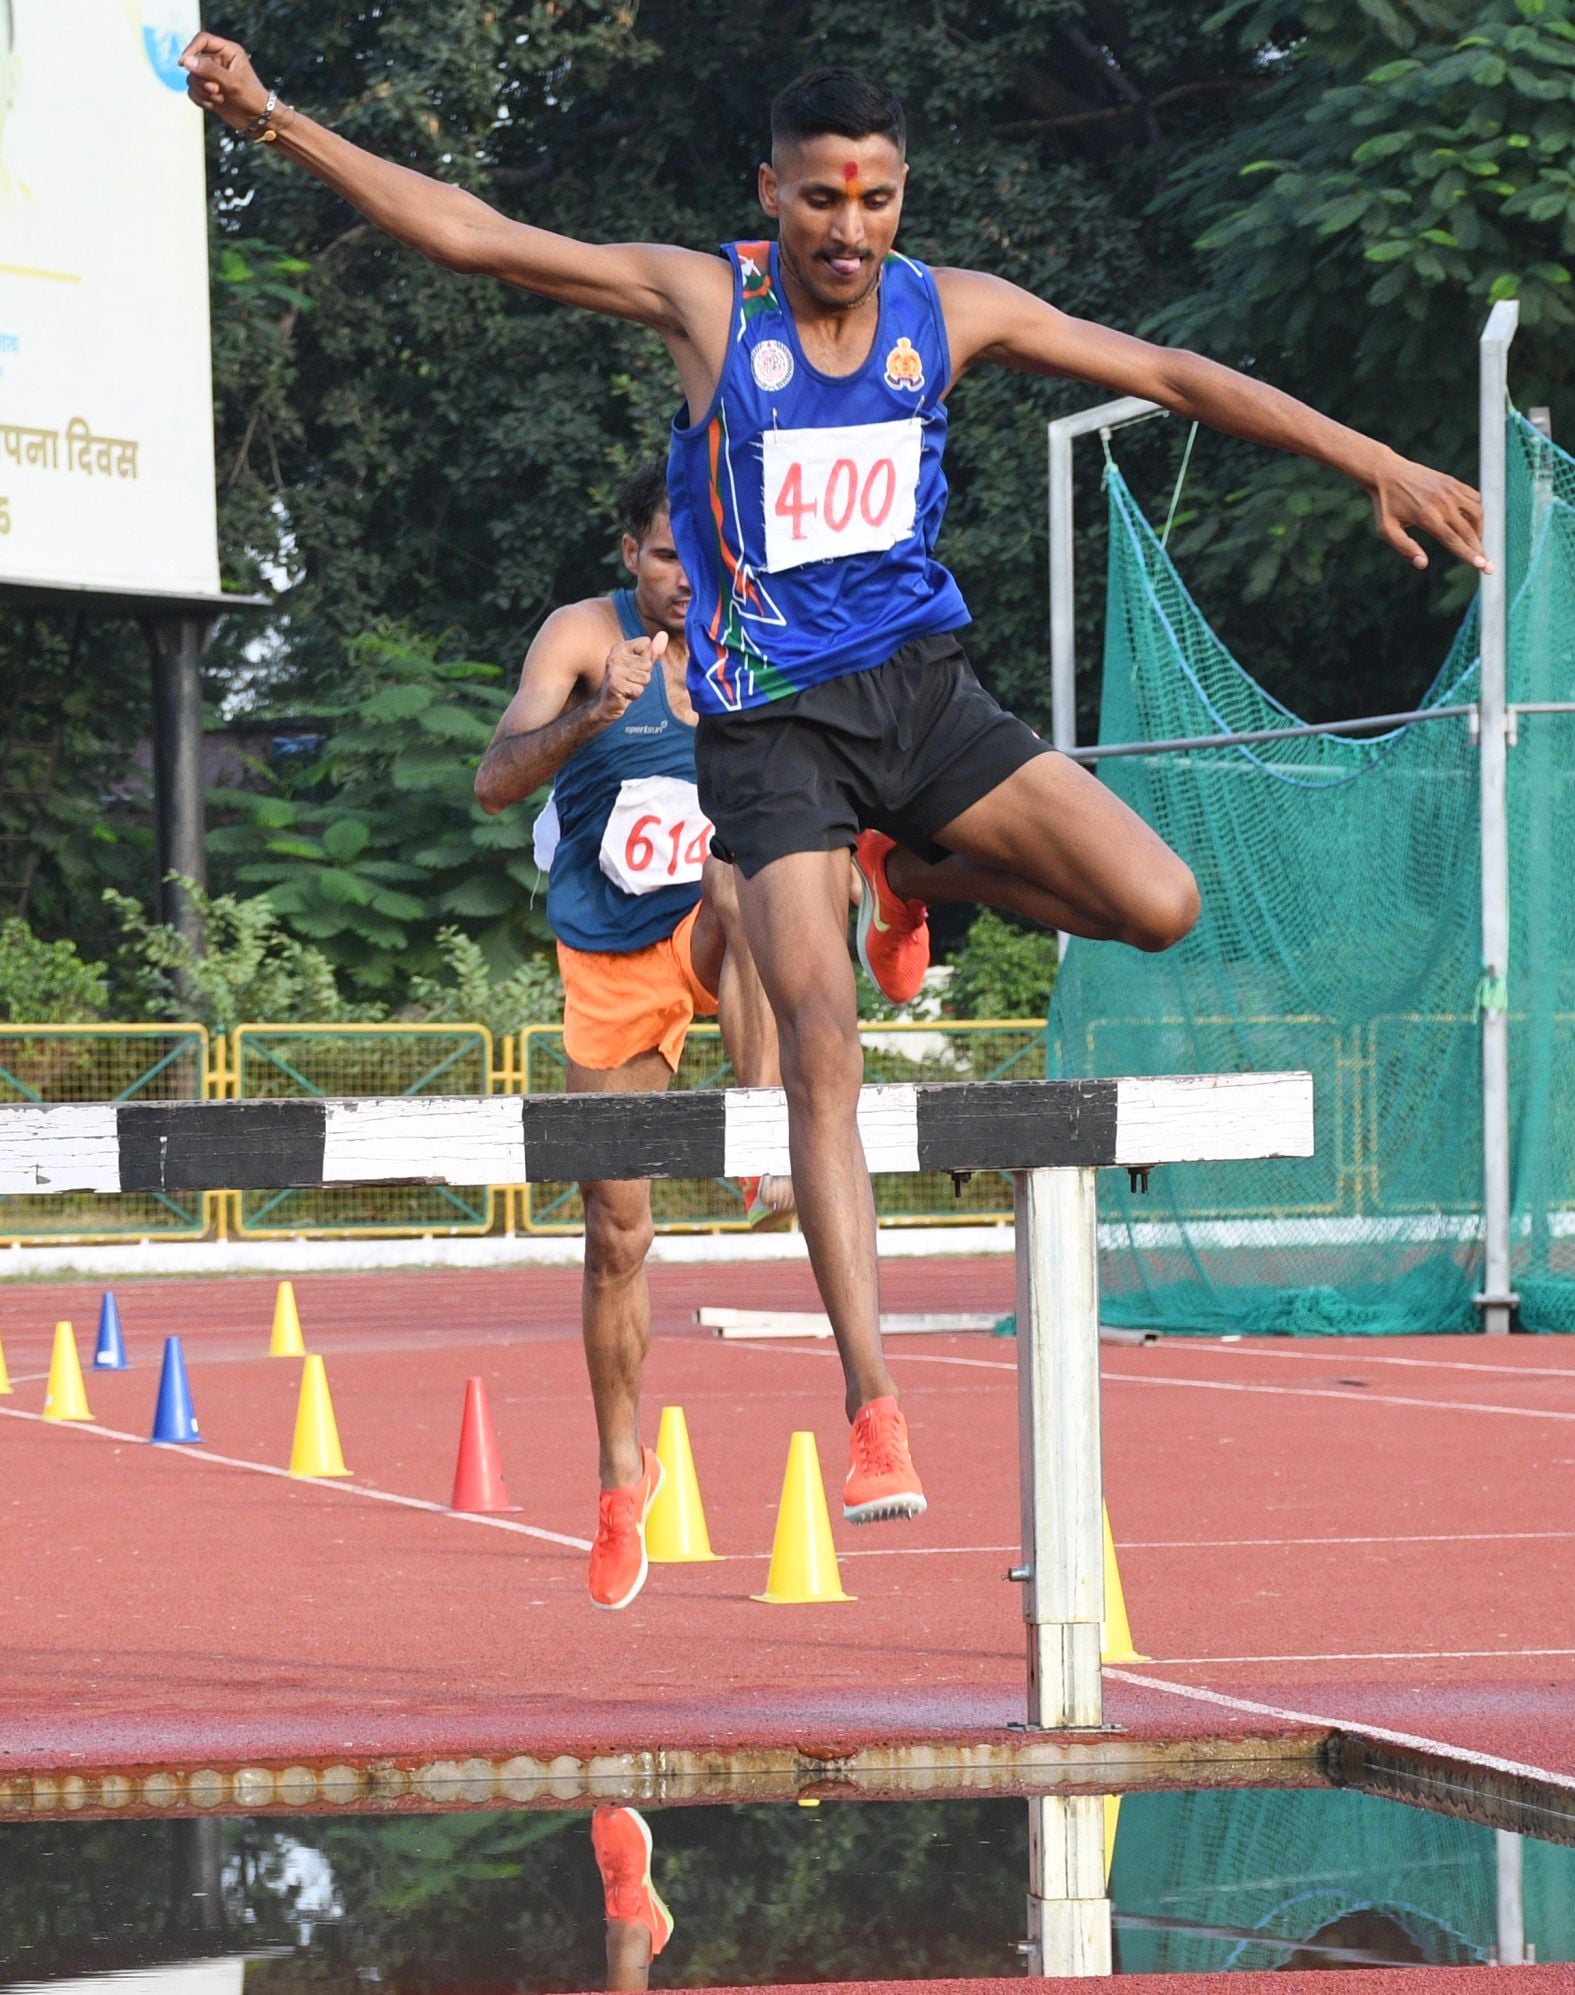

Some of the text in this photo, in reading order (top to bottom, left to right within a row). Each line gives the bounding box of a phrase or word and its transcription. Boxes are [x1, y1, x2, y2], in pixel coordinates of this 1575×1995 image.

[0, 416, 139, 479] पना दिवस
[775, 457, 897, 541] 400
